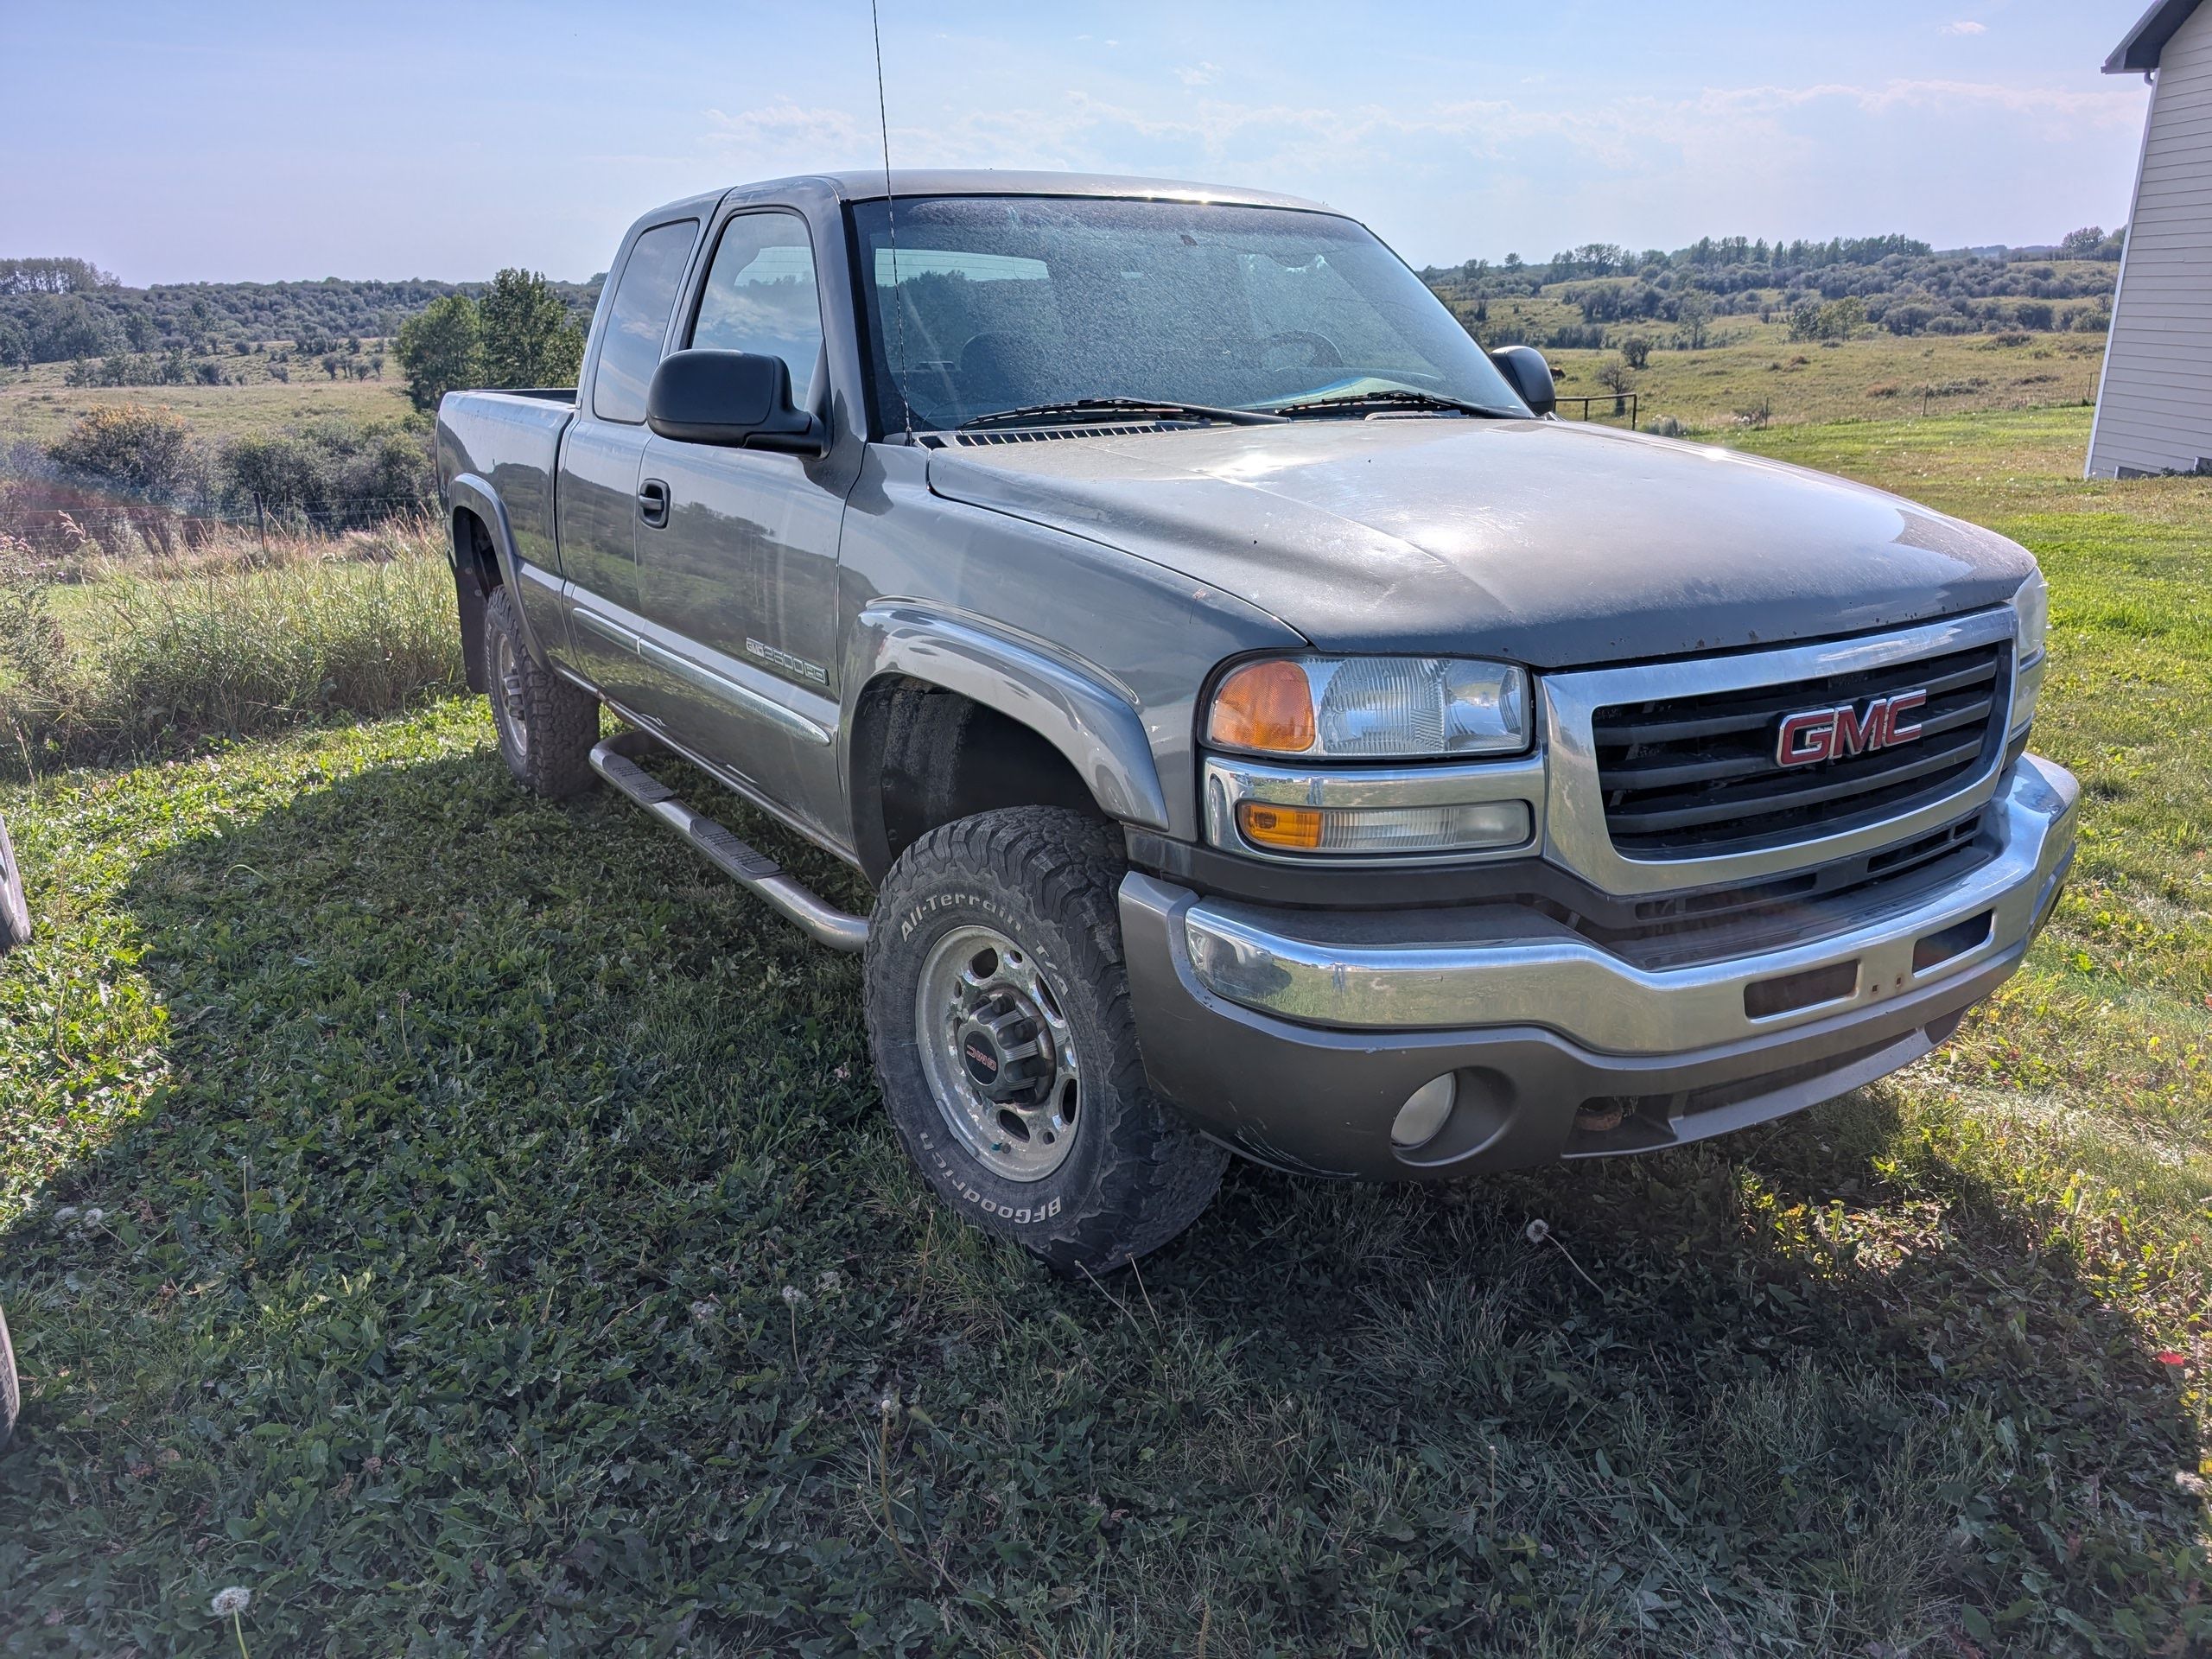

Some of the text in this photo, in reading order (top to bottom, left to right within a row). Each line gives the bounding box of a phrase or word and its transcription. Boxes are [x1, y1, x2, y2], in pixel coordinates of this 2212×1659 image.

[764, 645, 804, 676] 2500
[1776, 689, 1927, 768] GMC
[900, 892, 1069, 996] All-Terrain T/A
[966, 1044, 997, 1071] GMC
[919, 1132, 1062, 1224] BFGoodrich
